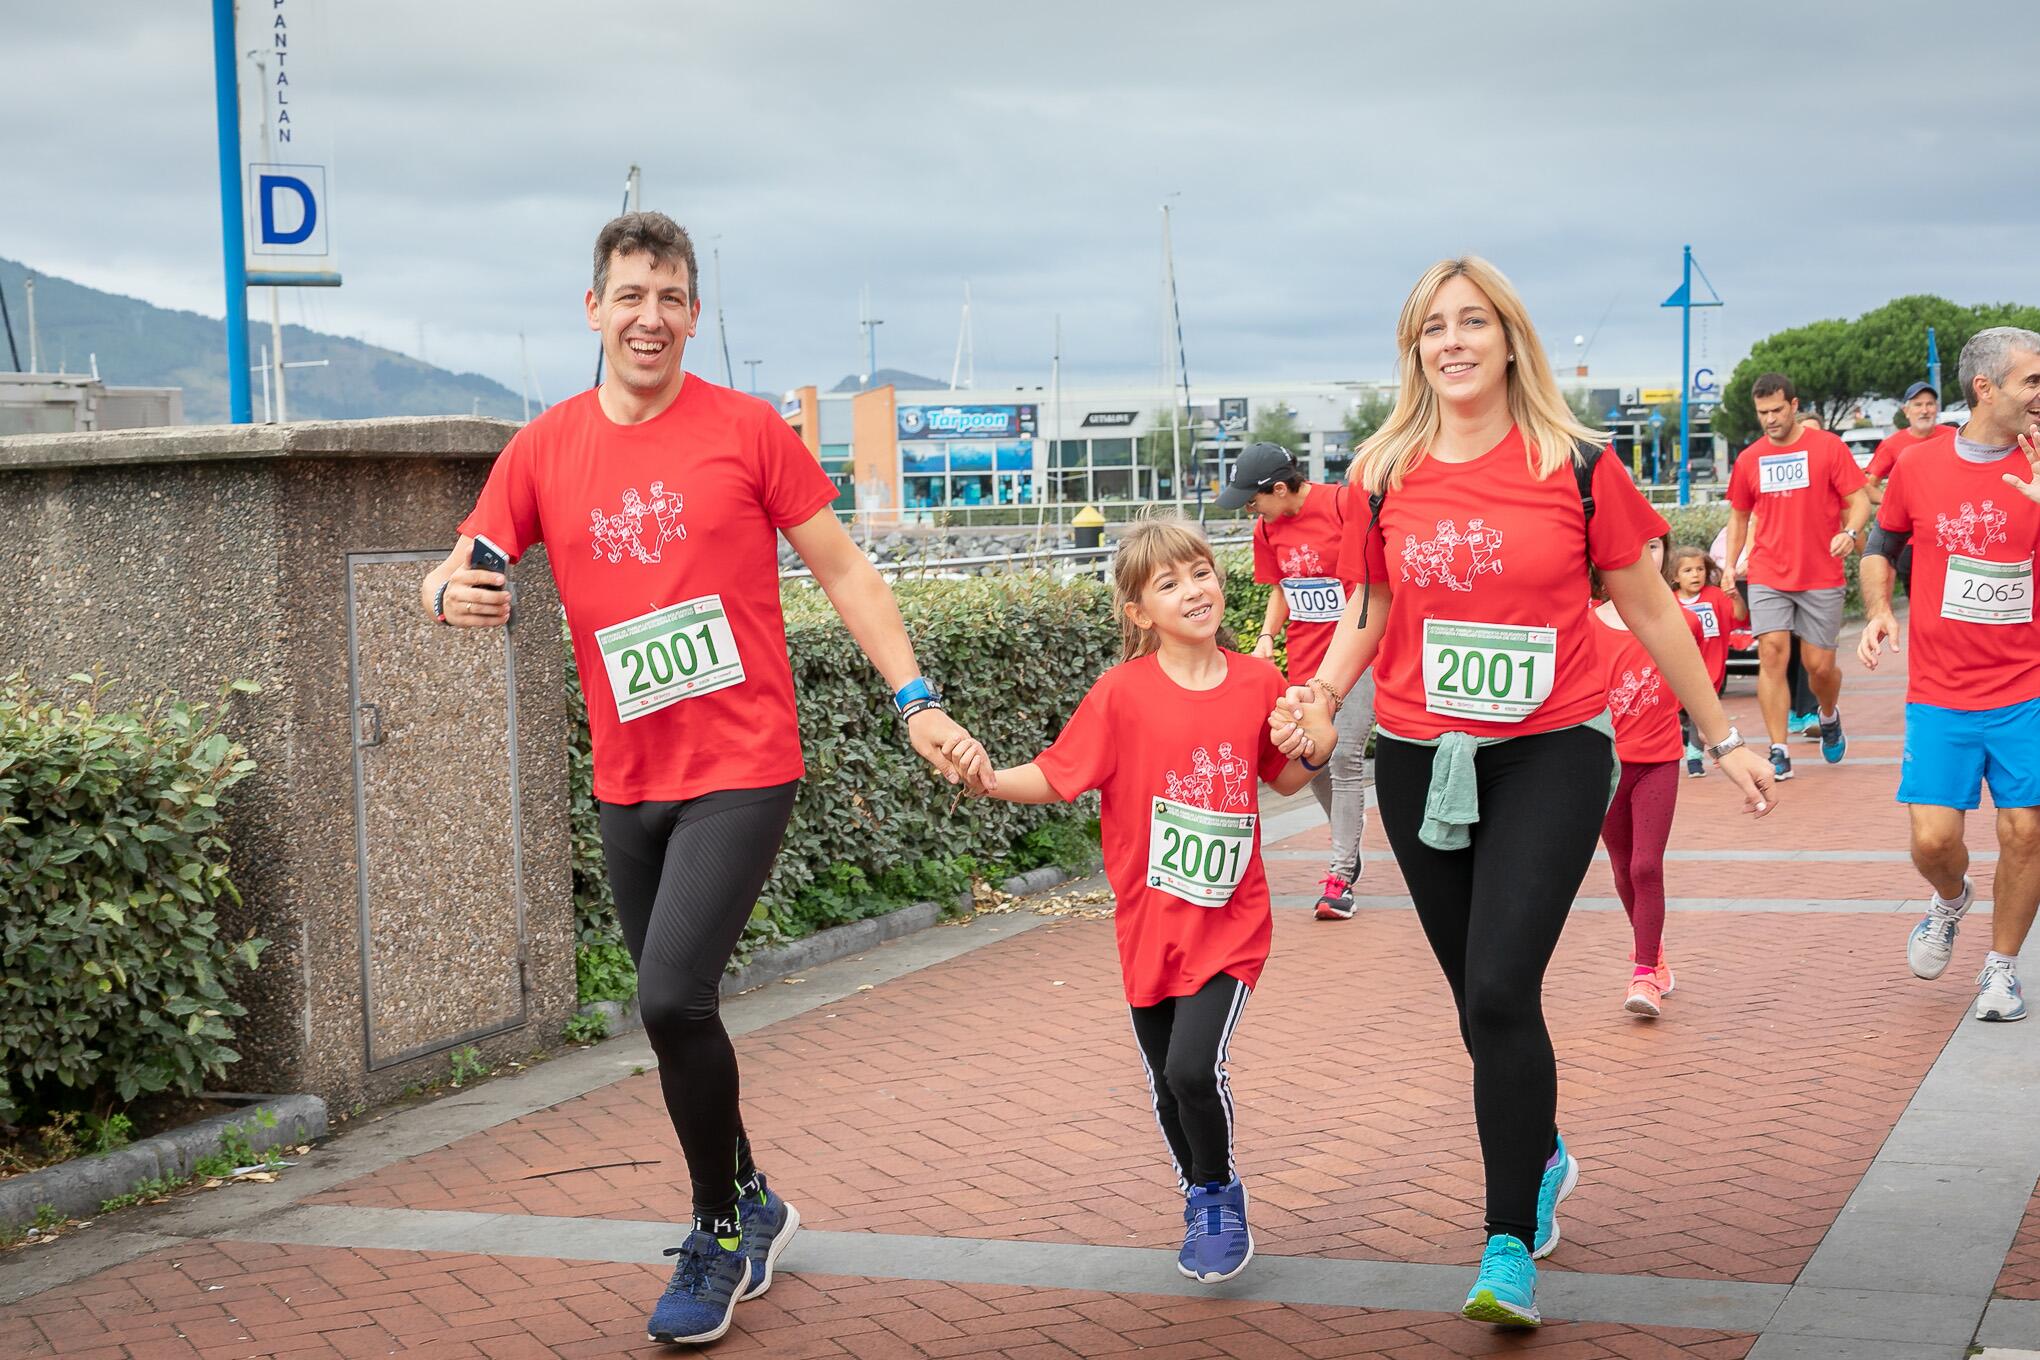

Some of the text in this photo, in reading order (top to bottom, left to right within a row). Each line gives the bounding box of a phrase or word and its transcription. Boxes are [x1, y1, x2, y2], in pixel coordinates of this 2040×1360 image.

[273, 0, 291, 142] PANTALAN
[260, 174, 316, 245] D
[1694, 368, 1715, 392] C
[928, 410, 1006, 432] Tarpoon
[1766, 462, 1803, 482] 1008
[1290, 588, 1339, 611] 1009
[1962, 579, 2025, 603] 2065
[620, 623, 719, 695] 2001
[1437, 648, 1535, 699] 2001
[1161, 826, 1241, 883] 2001
